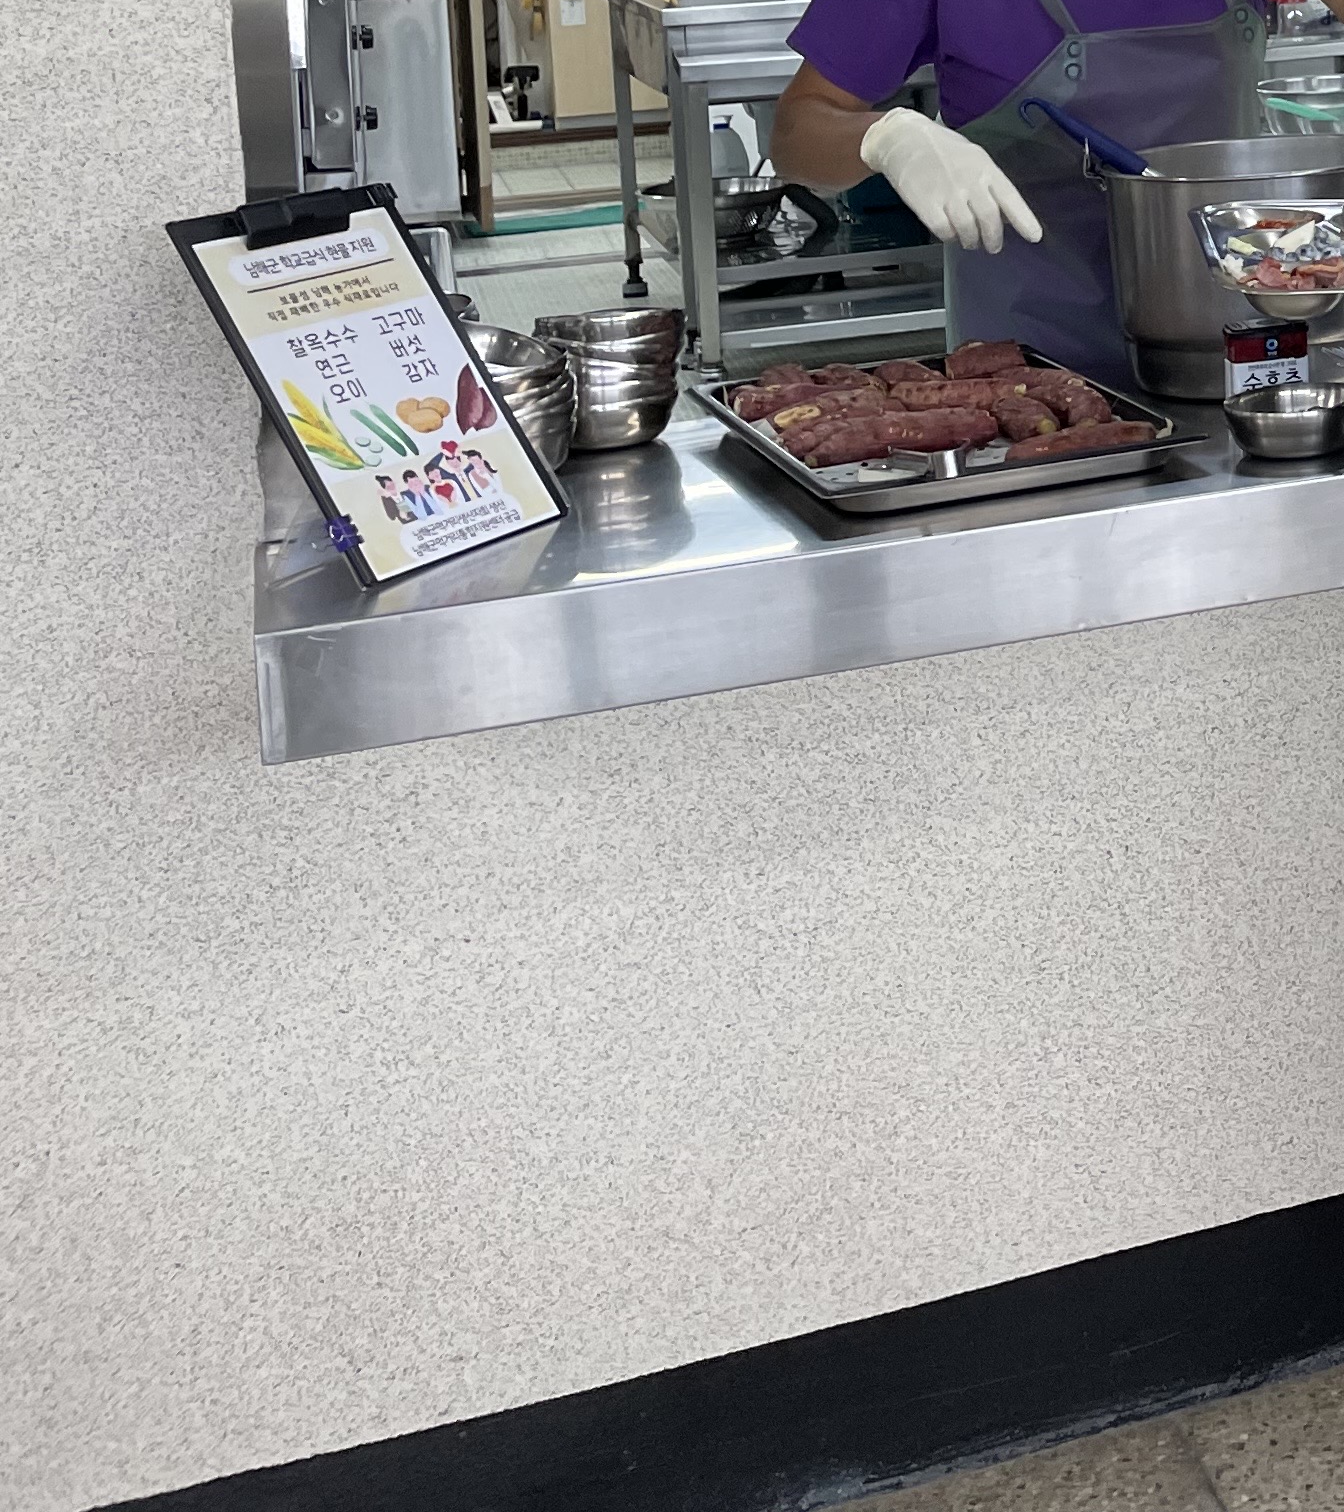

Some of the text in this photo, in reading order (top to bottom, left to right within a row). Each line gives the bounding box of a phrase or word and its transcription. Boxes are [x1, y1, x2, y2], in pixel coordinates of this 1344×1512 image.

[243, 258, 282, 278] 남해군
[279, 248, 328, 269] 학교급식
[350, 236, 377, 254] 지원
[286, 306, 425, 359] 찰옥수수 고구마
[315, 333, 427, 380] 연근 버섯
[329, 357, 439, 404] 오이 감자
